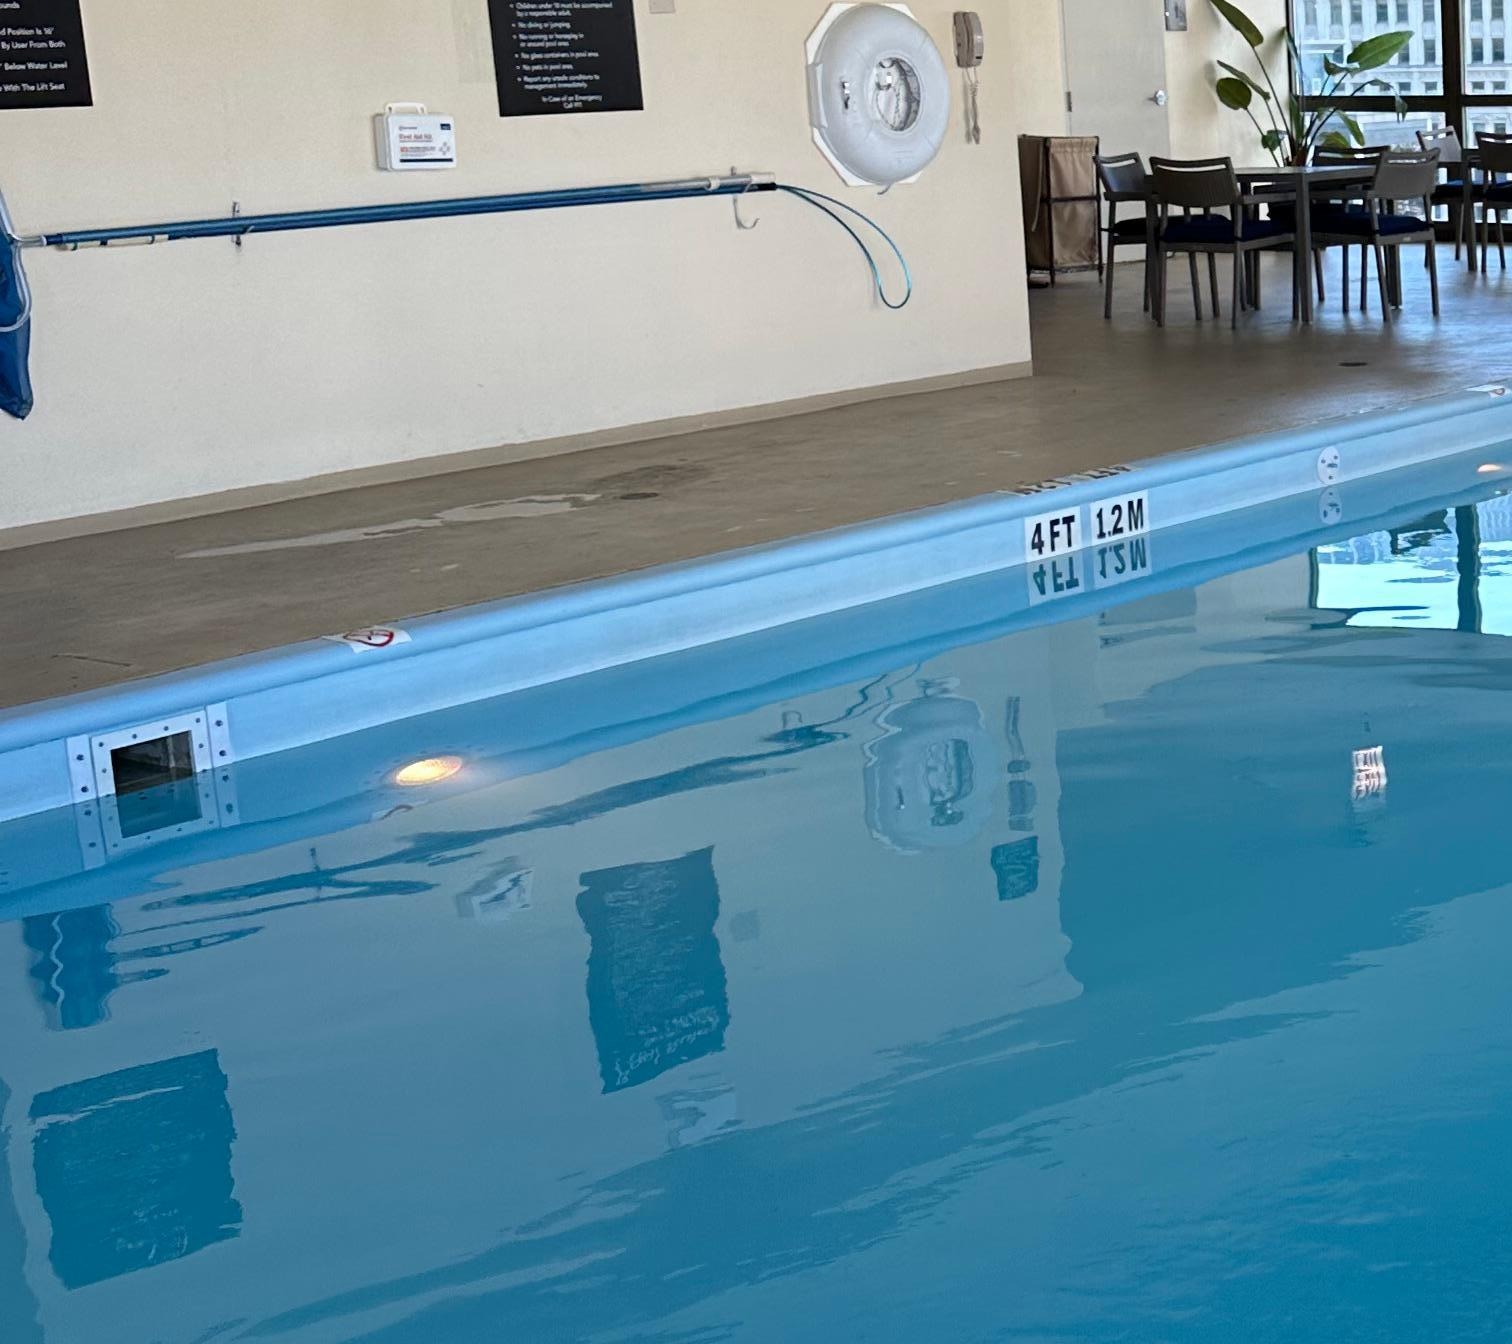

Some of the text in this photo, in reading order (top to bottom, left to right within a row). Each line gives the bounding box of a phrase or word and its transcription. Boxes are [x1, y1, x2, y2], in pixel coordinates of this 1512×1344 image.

[7, 27, 35, 36] Position
[11, 41, 28, 49] User
[29, 40, 48, 49] From
[48, 40, 66, 48] Both
[4, 63, 26, 71] Below
[26, 62, 48, 70] Water
[22, 83, 35, 92] The
[36, 83, 48, 91] Lift
